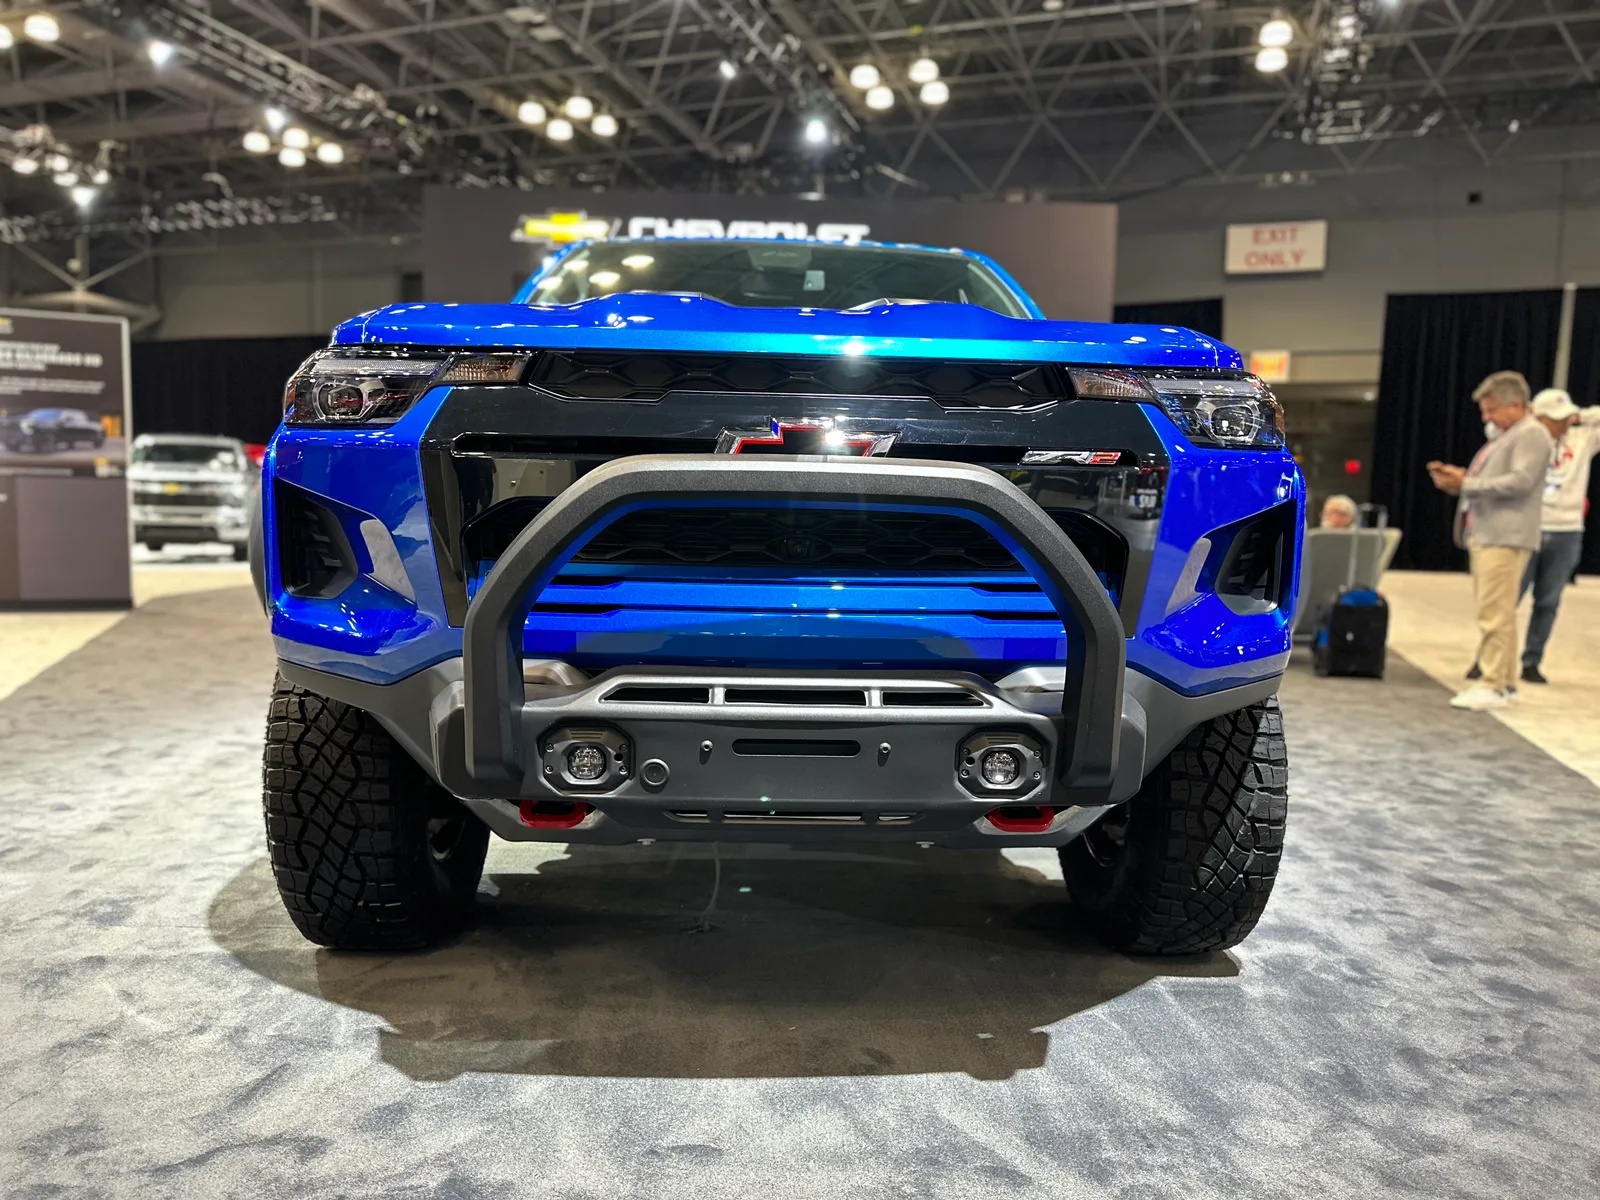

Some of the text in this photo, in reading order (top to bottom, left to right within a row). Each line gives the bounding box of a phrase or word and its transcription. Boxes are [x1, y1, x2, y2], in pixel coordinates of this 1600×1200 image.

[629, 217, 870, 243] CHEVROLET
[1252, 227, 1299, 245] EXIT
[1244, 251, 1304, 267] ONLY
[1020, 450, 1122, 464] ZR2
